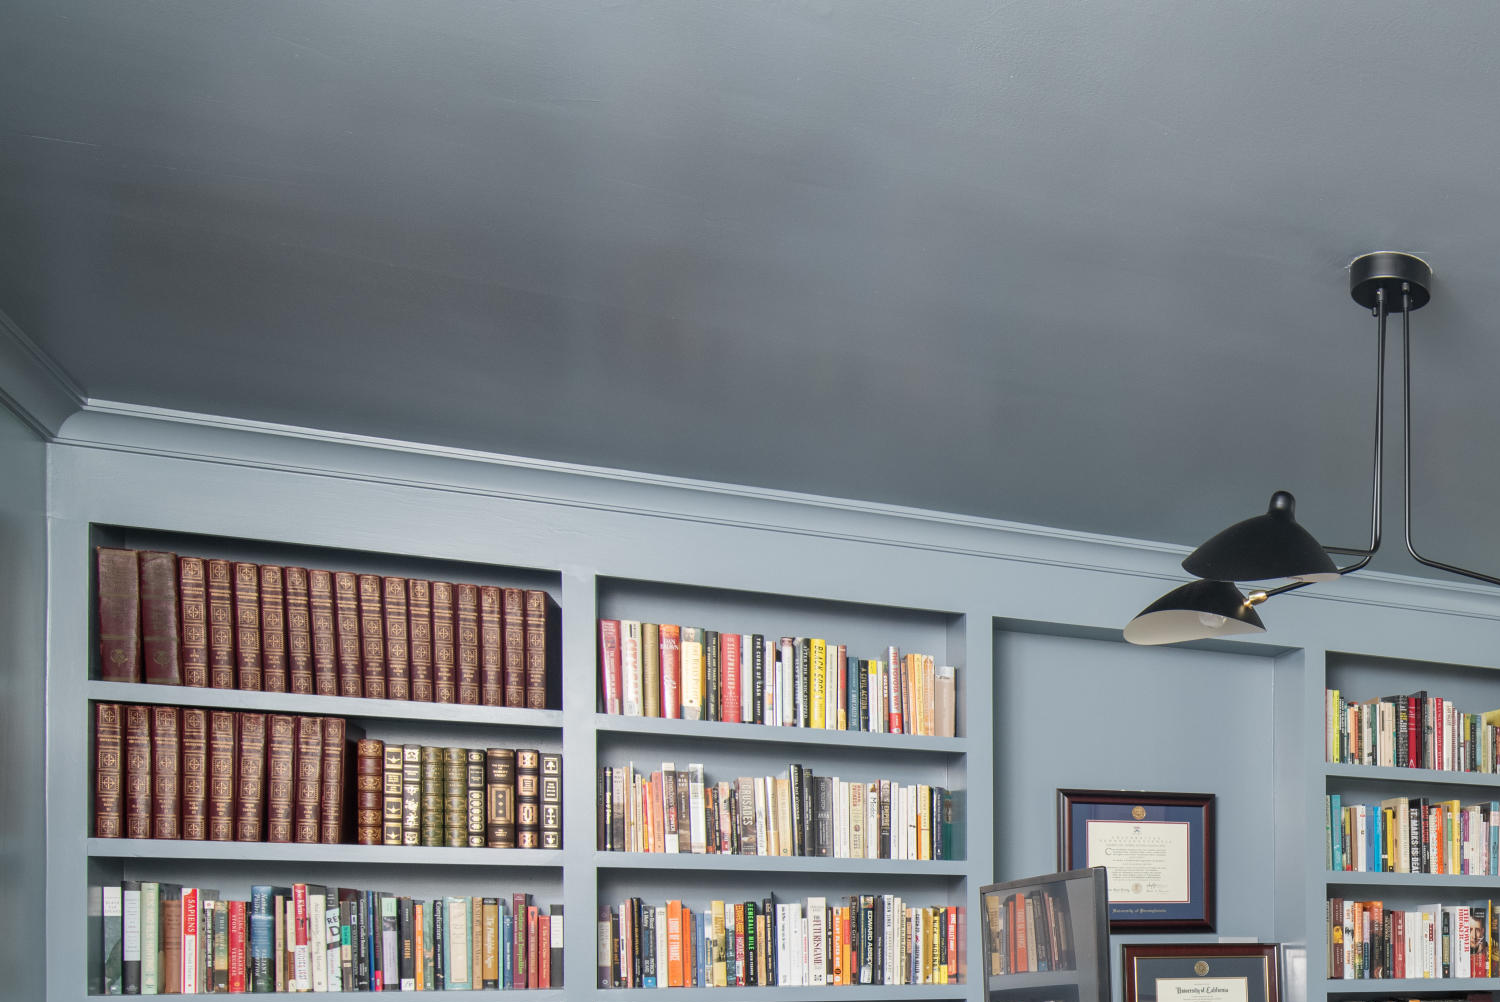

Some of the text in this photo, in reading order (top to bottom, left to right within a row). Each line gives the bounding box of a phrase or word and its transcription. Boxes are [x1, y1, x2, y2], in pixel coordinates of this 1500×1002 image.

[742, 784, 753, 826] CRUSADES
[1411, 819, 1419, 845] MARKS
[1411, 847, 1419, 855] IS
[295, 889, 303, 898] Joe
[187, 899, 196, 933] SAPIENS
[435, 901, 443, 940] Complications
[747, 907, 755, 935] EMERALD
[669, 941, 681, 962] FINANCE
[813, 919, 822, 966] FUTURES GAME
[1176, 987, 1200, 995] University
[1206, 986, 1229, 994] California
